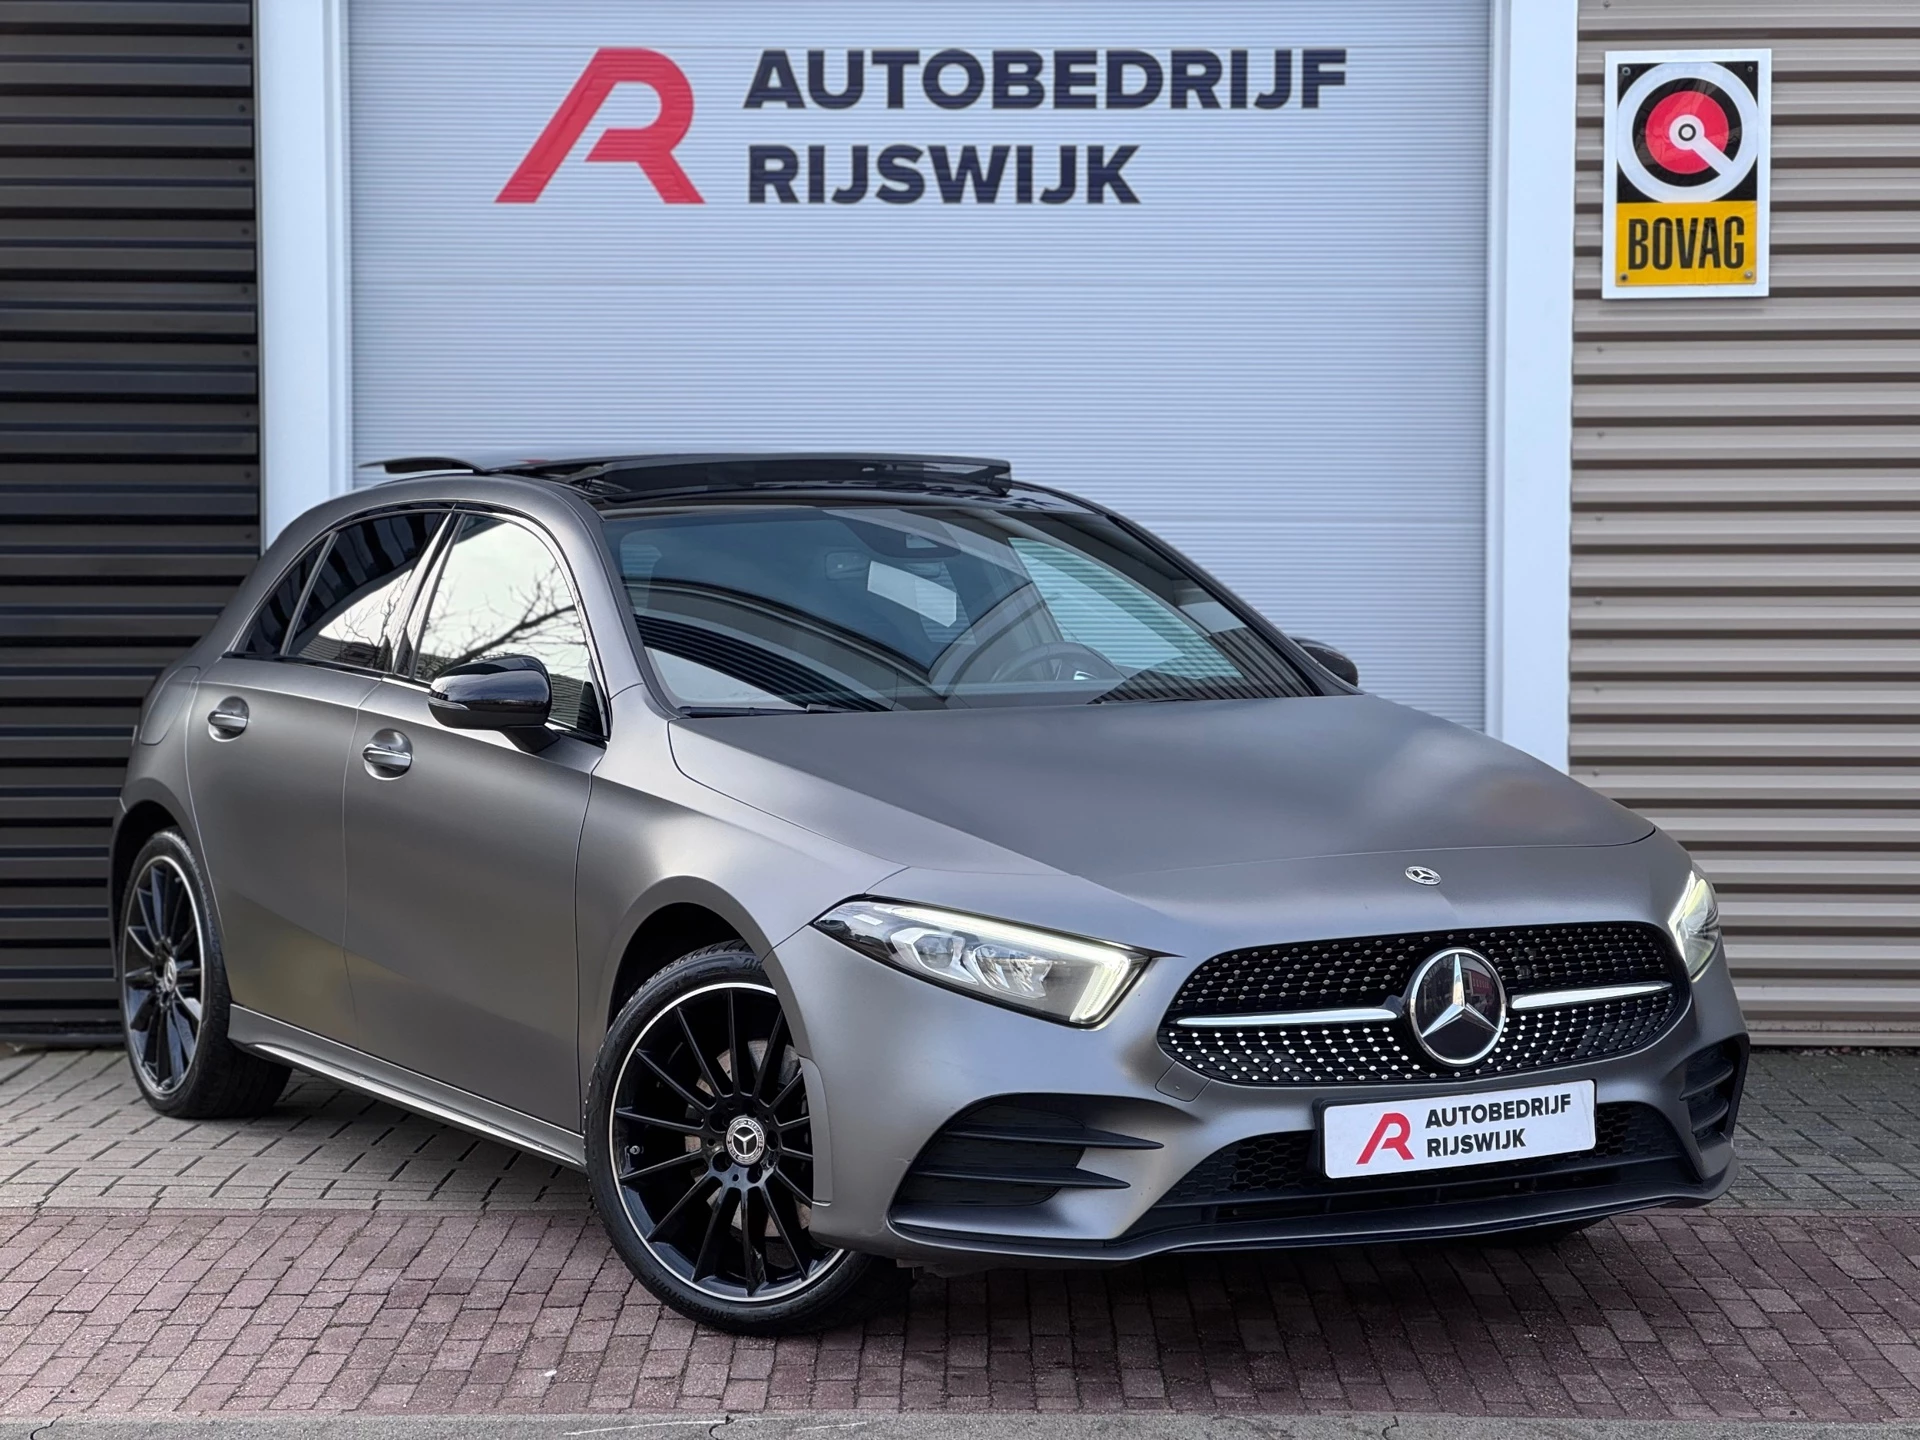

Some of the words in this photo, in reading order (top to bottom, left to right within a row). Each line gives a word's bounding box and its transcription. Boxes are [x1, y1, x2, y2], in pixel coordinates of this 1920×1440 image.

[743, 48, 1347, 110] AUTOBEDRIJF
[748, 144, 1141, 205] RIJSWIJK
[1627, 215, 1745, 271] BOVAG
[1425, 1094, 1571, 1129] AUTOBEDRIJF
[1427, 1128, 1526, 1158] RIJSWIJK
